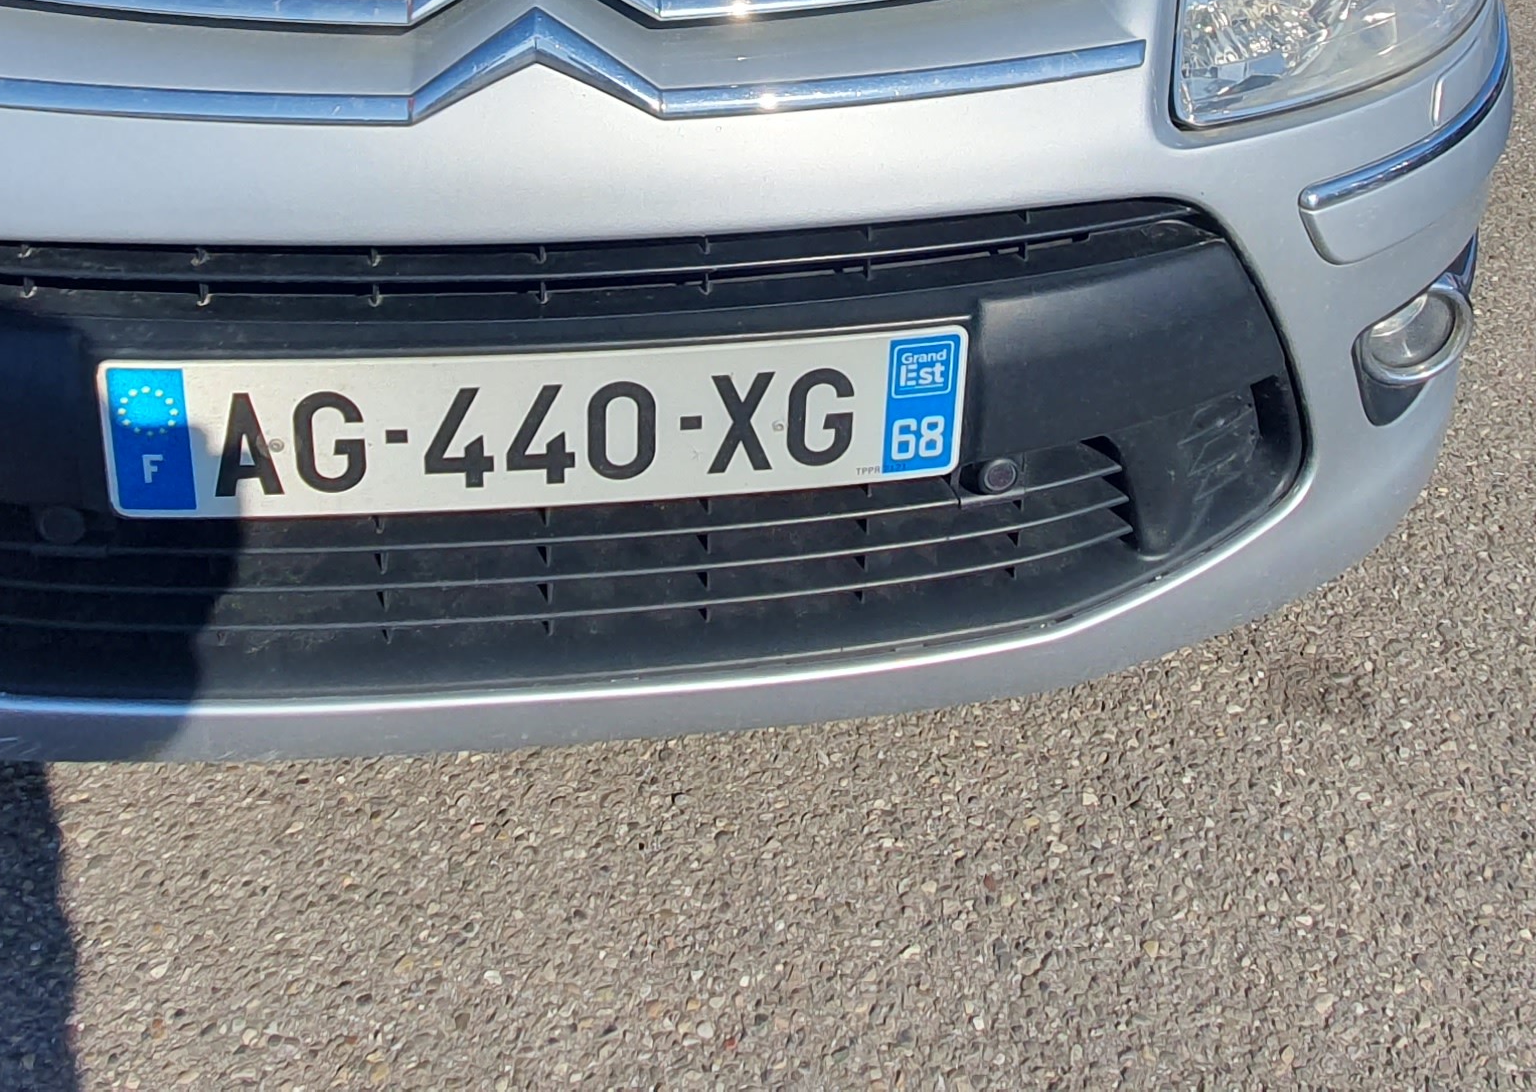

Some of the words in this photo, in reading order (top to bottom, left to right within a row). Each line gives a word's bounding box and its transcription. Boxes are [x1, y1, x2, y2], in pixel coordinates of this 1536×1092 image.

[901, 348, 947, 365] Grand
[899, 362, 945, 387] Est
[214, 367, 855, 497] AG-440-XG
[890, 415, 945, 461] 68
[140, 453, 164, 484] F
